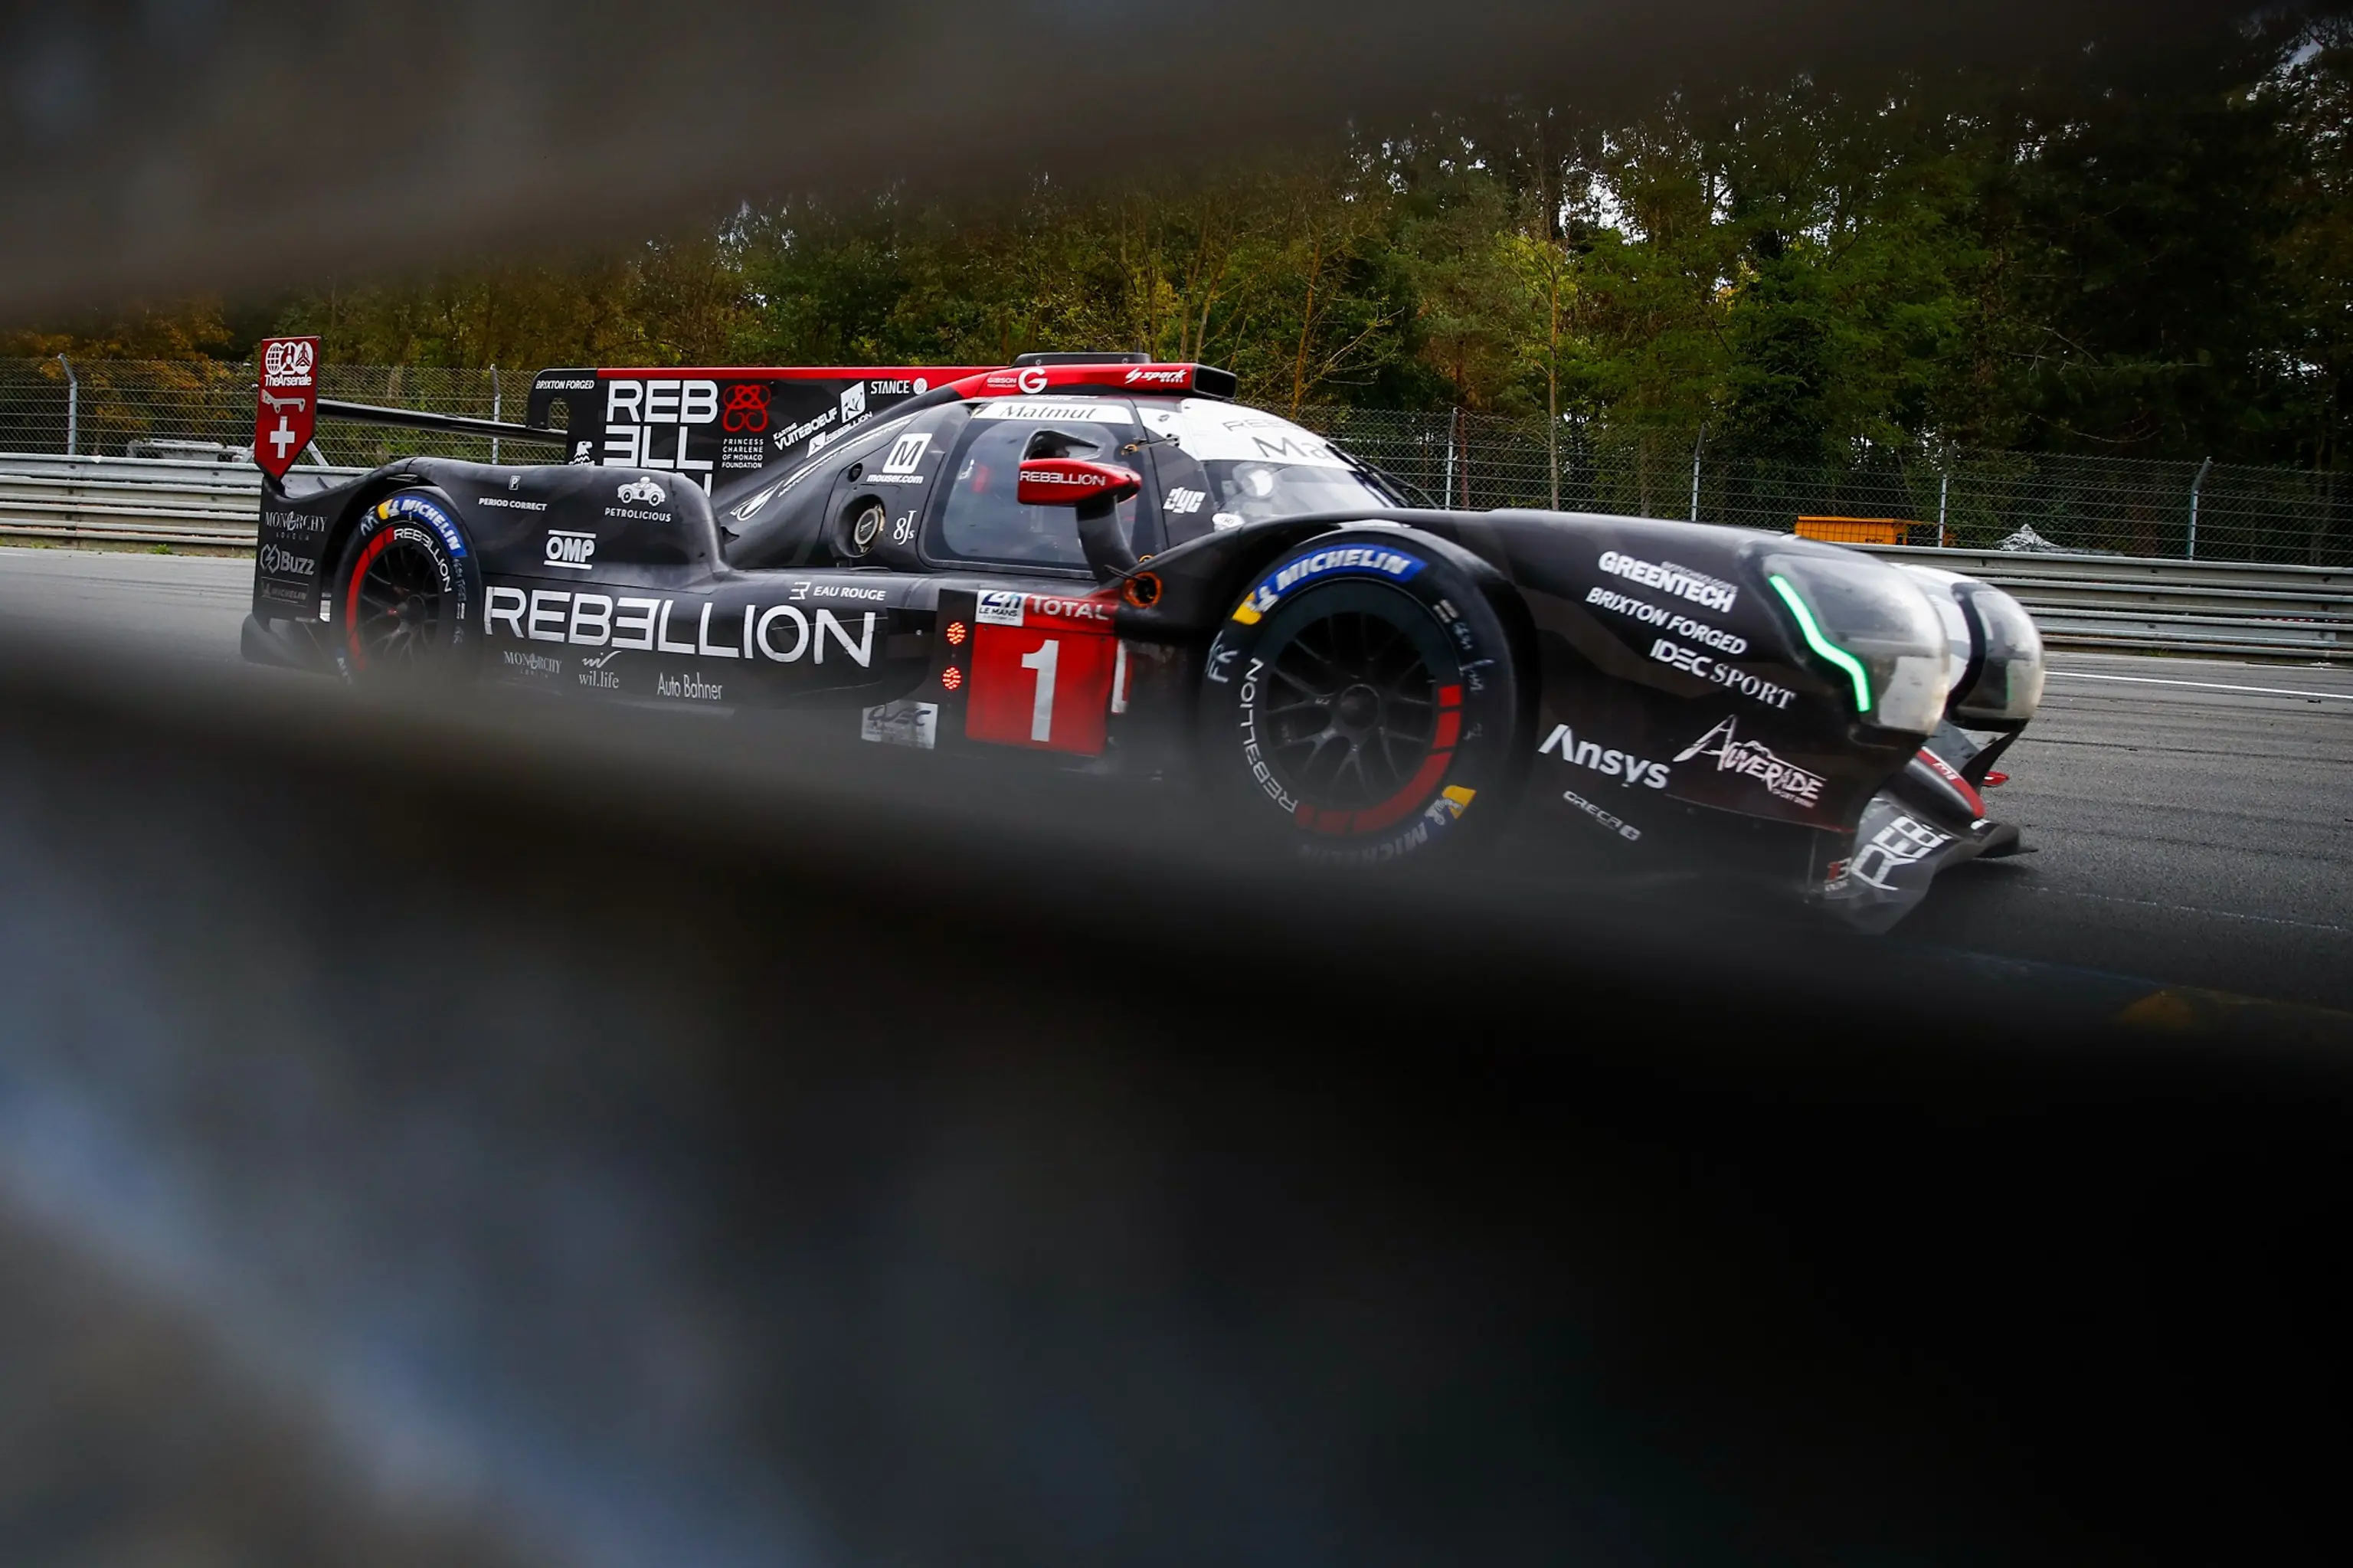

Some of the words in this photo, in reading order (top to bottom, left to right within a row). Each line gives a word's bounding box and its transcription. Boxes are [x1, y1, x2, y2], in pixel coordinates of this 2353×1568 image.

[264, 375, 313, 386] TheArsenale
[535, 380, 565, 390] BRIXTON
[565, 380, 594, 389] FORGED
[870, 380, 910, 394] STANCE
[999, 405, 1097, 420] Matmut
[774, 407, 839, 451] VUITEBOEUF
[866, 473, 924, 484] mouser.com
[478, 497, 509, 508] PERIOD
[509, 500, 548, 512] CORRECT
[604, 507, 672, 523] PETROLICIOUS
[401, 499, 461, 552] MICHELIN
[545, 536, 595, 564] OMP
[1275, 548, 1412, 591] MICHELIN
[1598, 551, 1737, 614] GREENTECH
[813, 585, 839, 598] EAU
[839, 587, 886, 602] ROUGE
[1031, 595, 1110, 621] TOTAL
[1586, 587, 1670, 628] BRIXTON
[1666, 615, 1748, 656] FORGED
[579, 670, 620, 689] wil.life
[657, 672, 682, 698] Auto
[683, 672, 722, 700] Bahner
[1649, 638, 1715, 678] IDEC
[1710, 663, 1797, 710] SPORT
[1021, 639, 1059, 742] 1
[1537, 723, 1671, 790] Ansys
